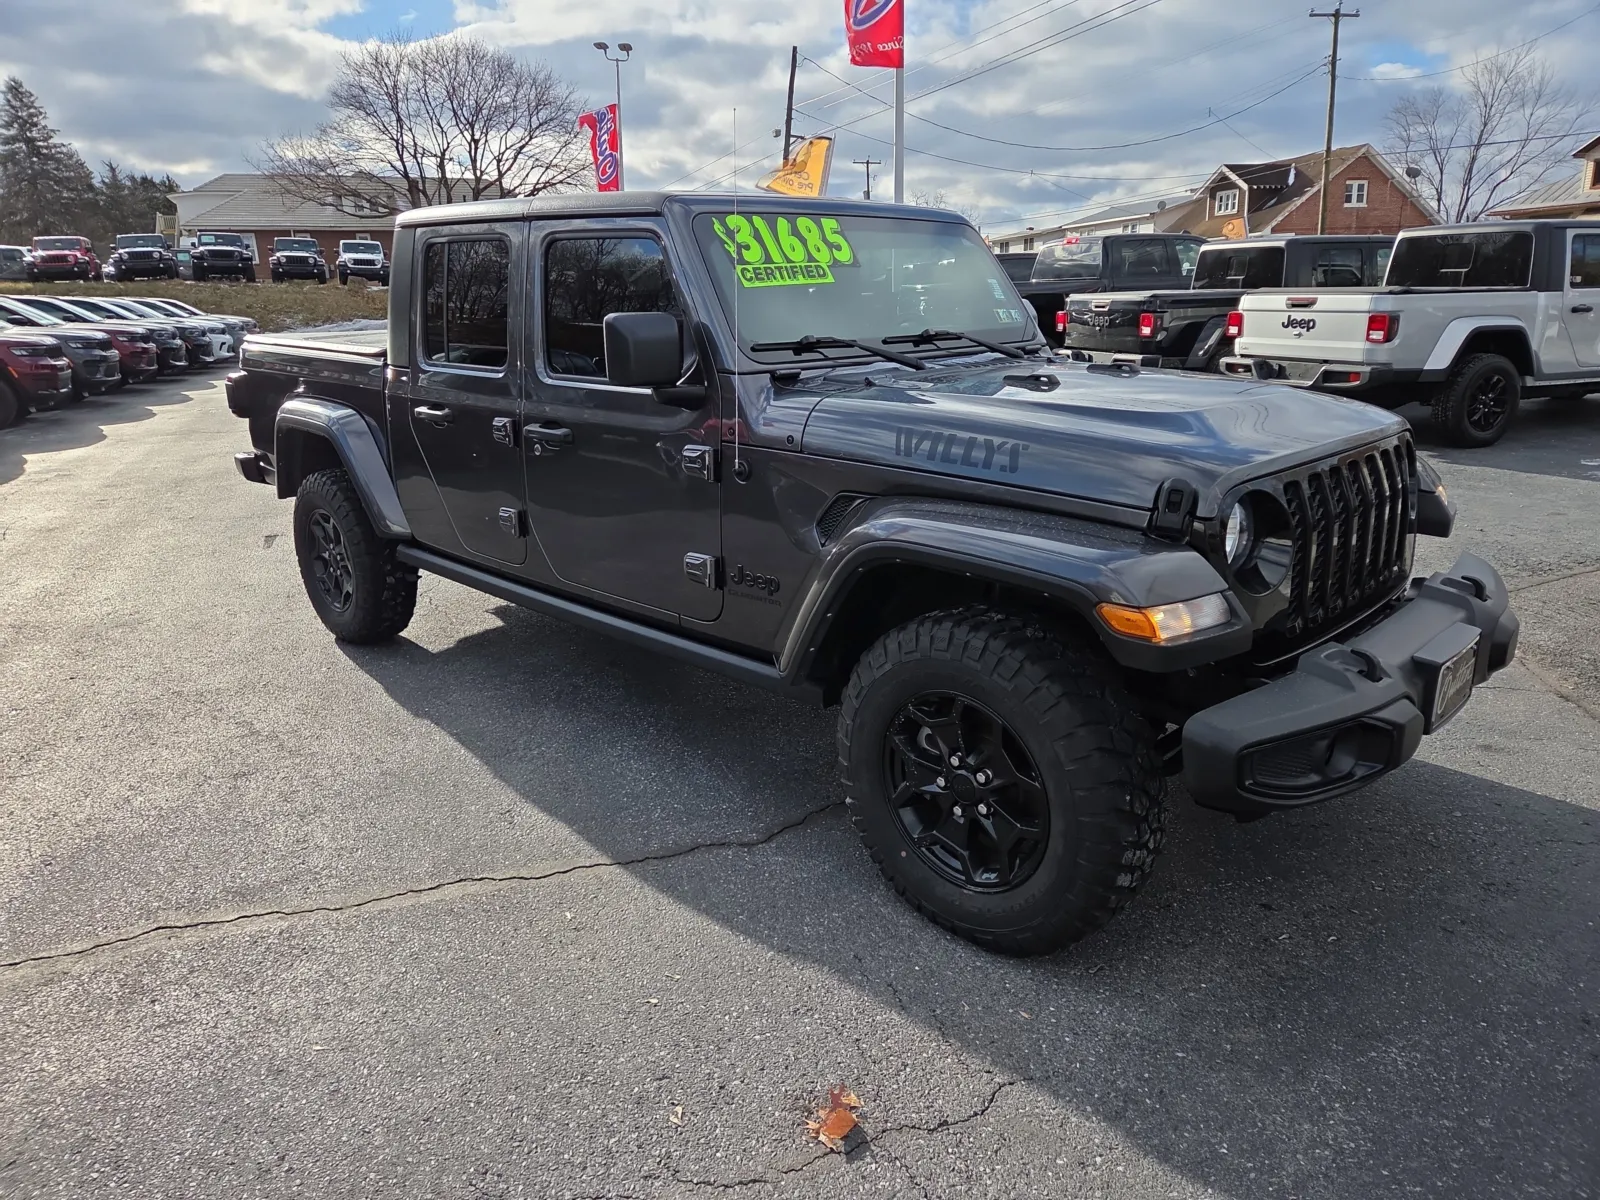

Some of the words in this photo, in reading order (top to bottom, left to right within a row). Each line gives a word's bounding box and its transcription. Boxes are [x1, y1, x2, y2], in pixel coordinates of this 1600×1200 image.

[712, 214, 853, 265] $31685
[740, 264, 828, 284] CERTIFIED
[1088, 313, 1110, 329] Jeep
[1281, 314, 1317, 332] Jeep
[895, 426, 1030, 474] WILLYS
[730, 564, 781, 596] Jeep
